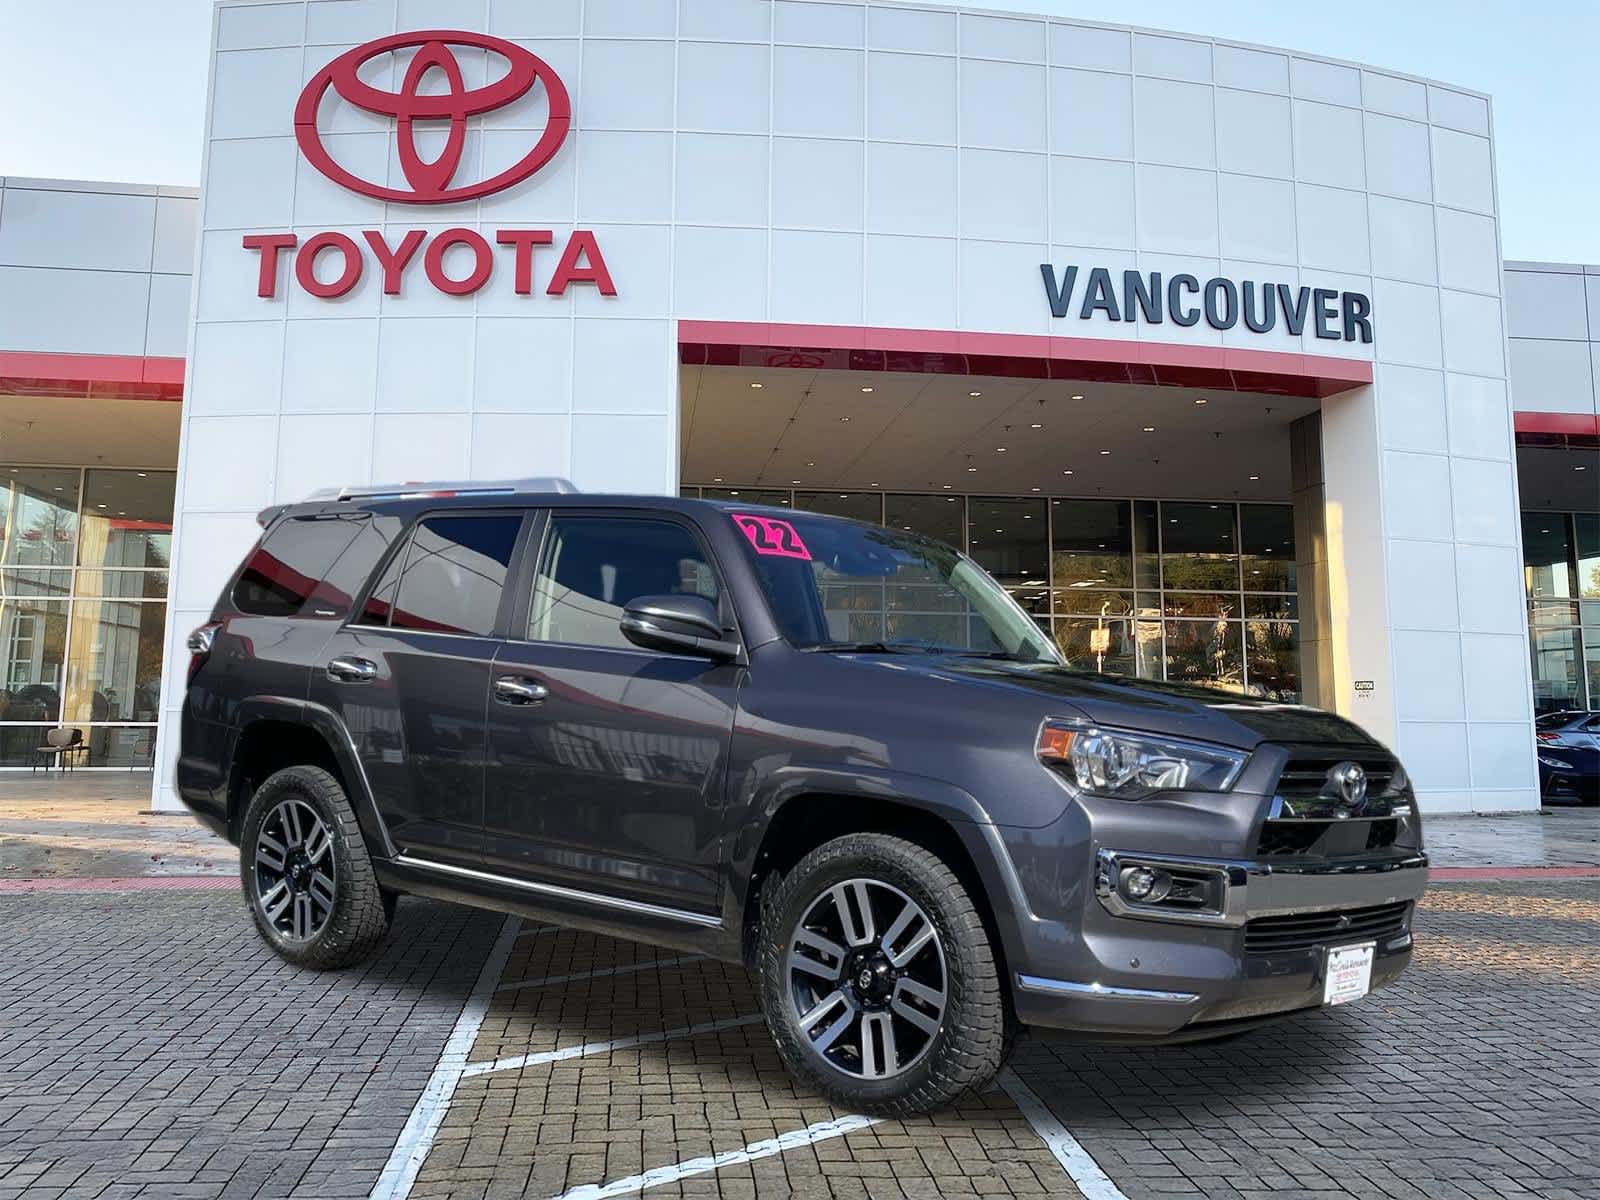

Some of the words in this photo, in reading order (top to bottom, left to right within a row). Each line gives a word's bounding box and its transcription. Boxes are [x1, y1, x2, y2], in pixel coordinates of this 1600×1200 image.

[243, 228, 616, 298] TOYOTA
[1040, 264, 1373, 343] VANCOUVER
[740, 518, 803, 553] 22
